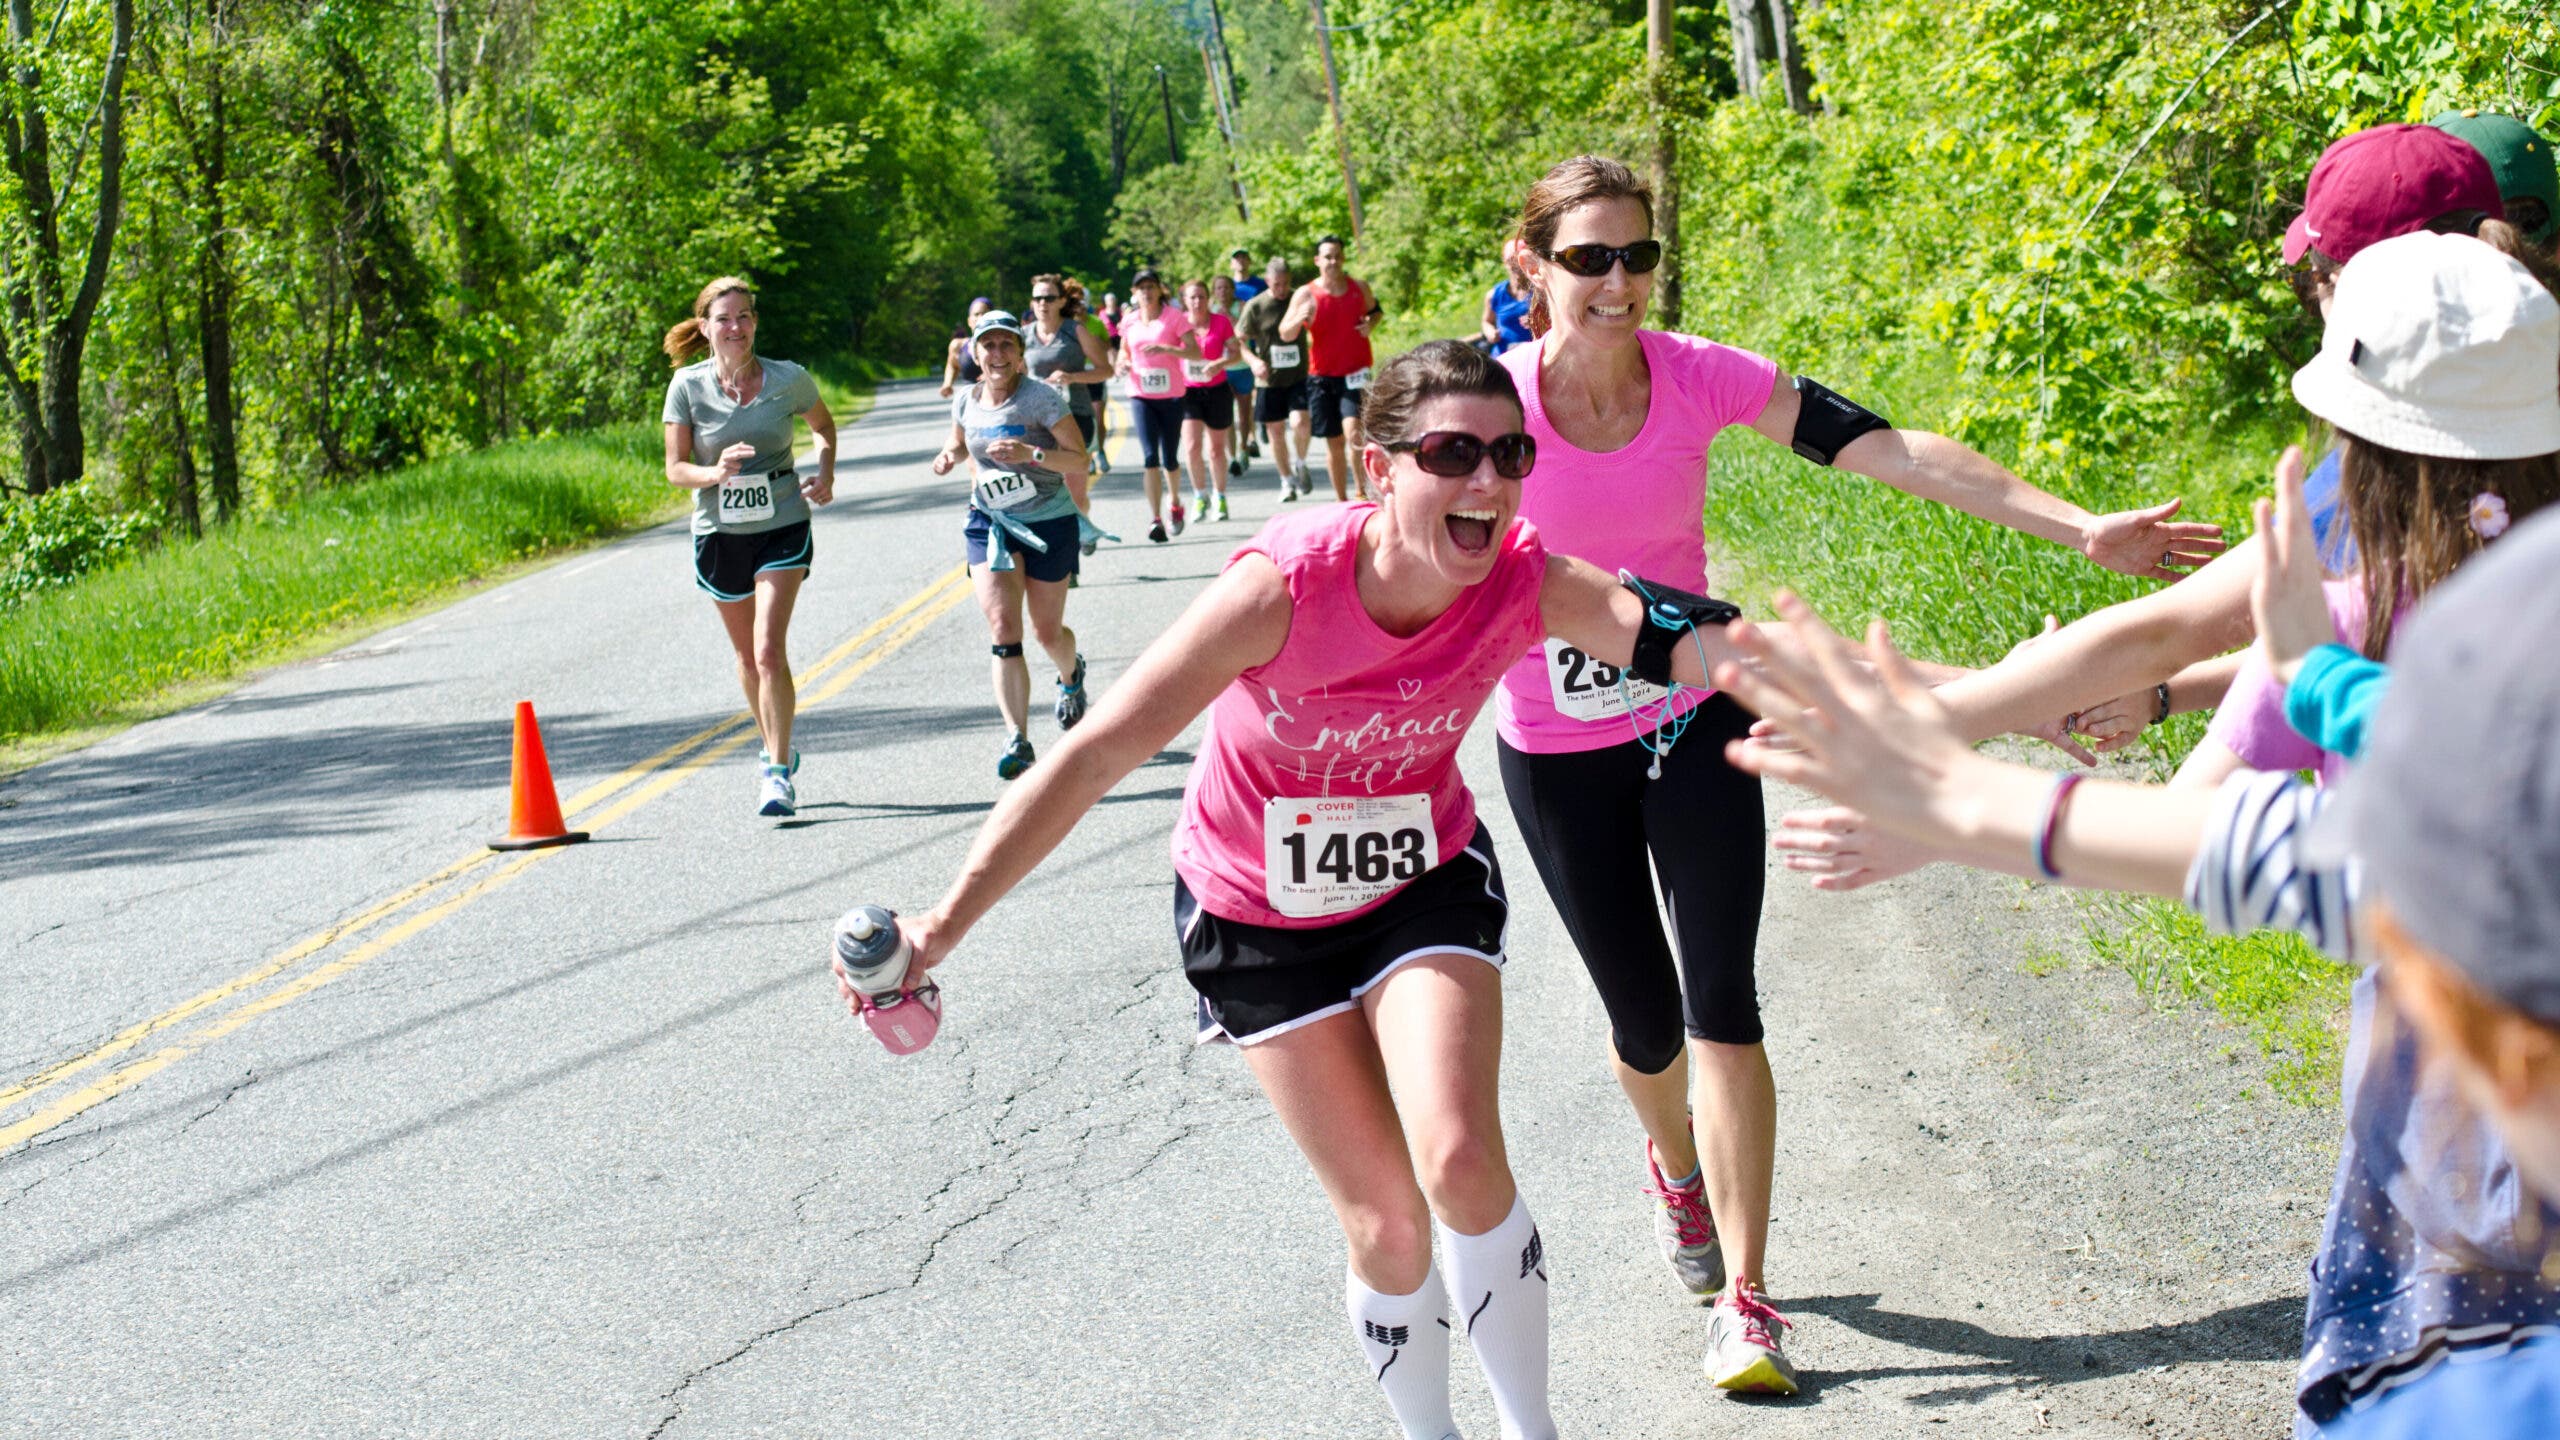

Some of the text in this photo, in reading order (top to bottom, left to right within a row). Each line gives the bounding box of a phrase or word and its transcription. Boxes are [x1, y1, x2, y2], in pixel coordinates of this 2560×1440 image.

[983, 473, 1024, 499] 1127
[723, 486, 769, 509] 2208
[1566, 695, 1580, 703] The
[1581, 692, 1595, 701] best
[1597, 689, 1611, 698] 13.1
[1602, 698, 1621, 708] June
[1632, 687, 1651, 699] 2014
[1266, 687, 1468, 753] Embrace
[1316, 802, 1355, 812] COVER
[1282, 827, 1426, 884] 1463
[1282, 885, 1297, 893] The
[1300, 885, 1317, 894] best
[1320, 885, 1336, 893] 13.1
[1338, 884, 1360, 892] miles
[1373, 883, 1391, 891] New
[1323, 895, 1345, 905] June
